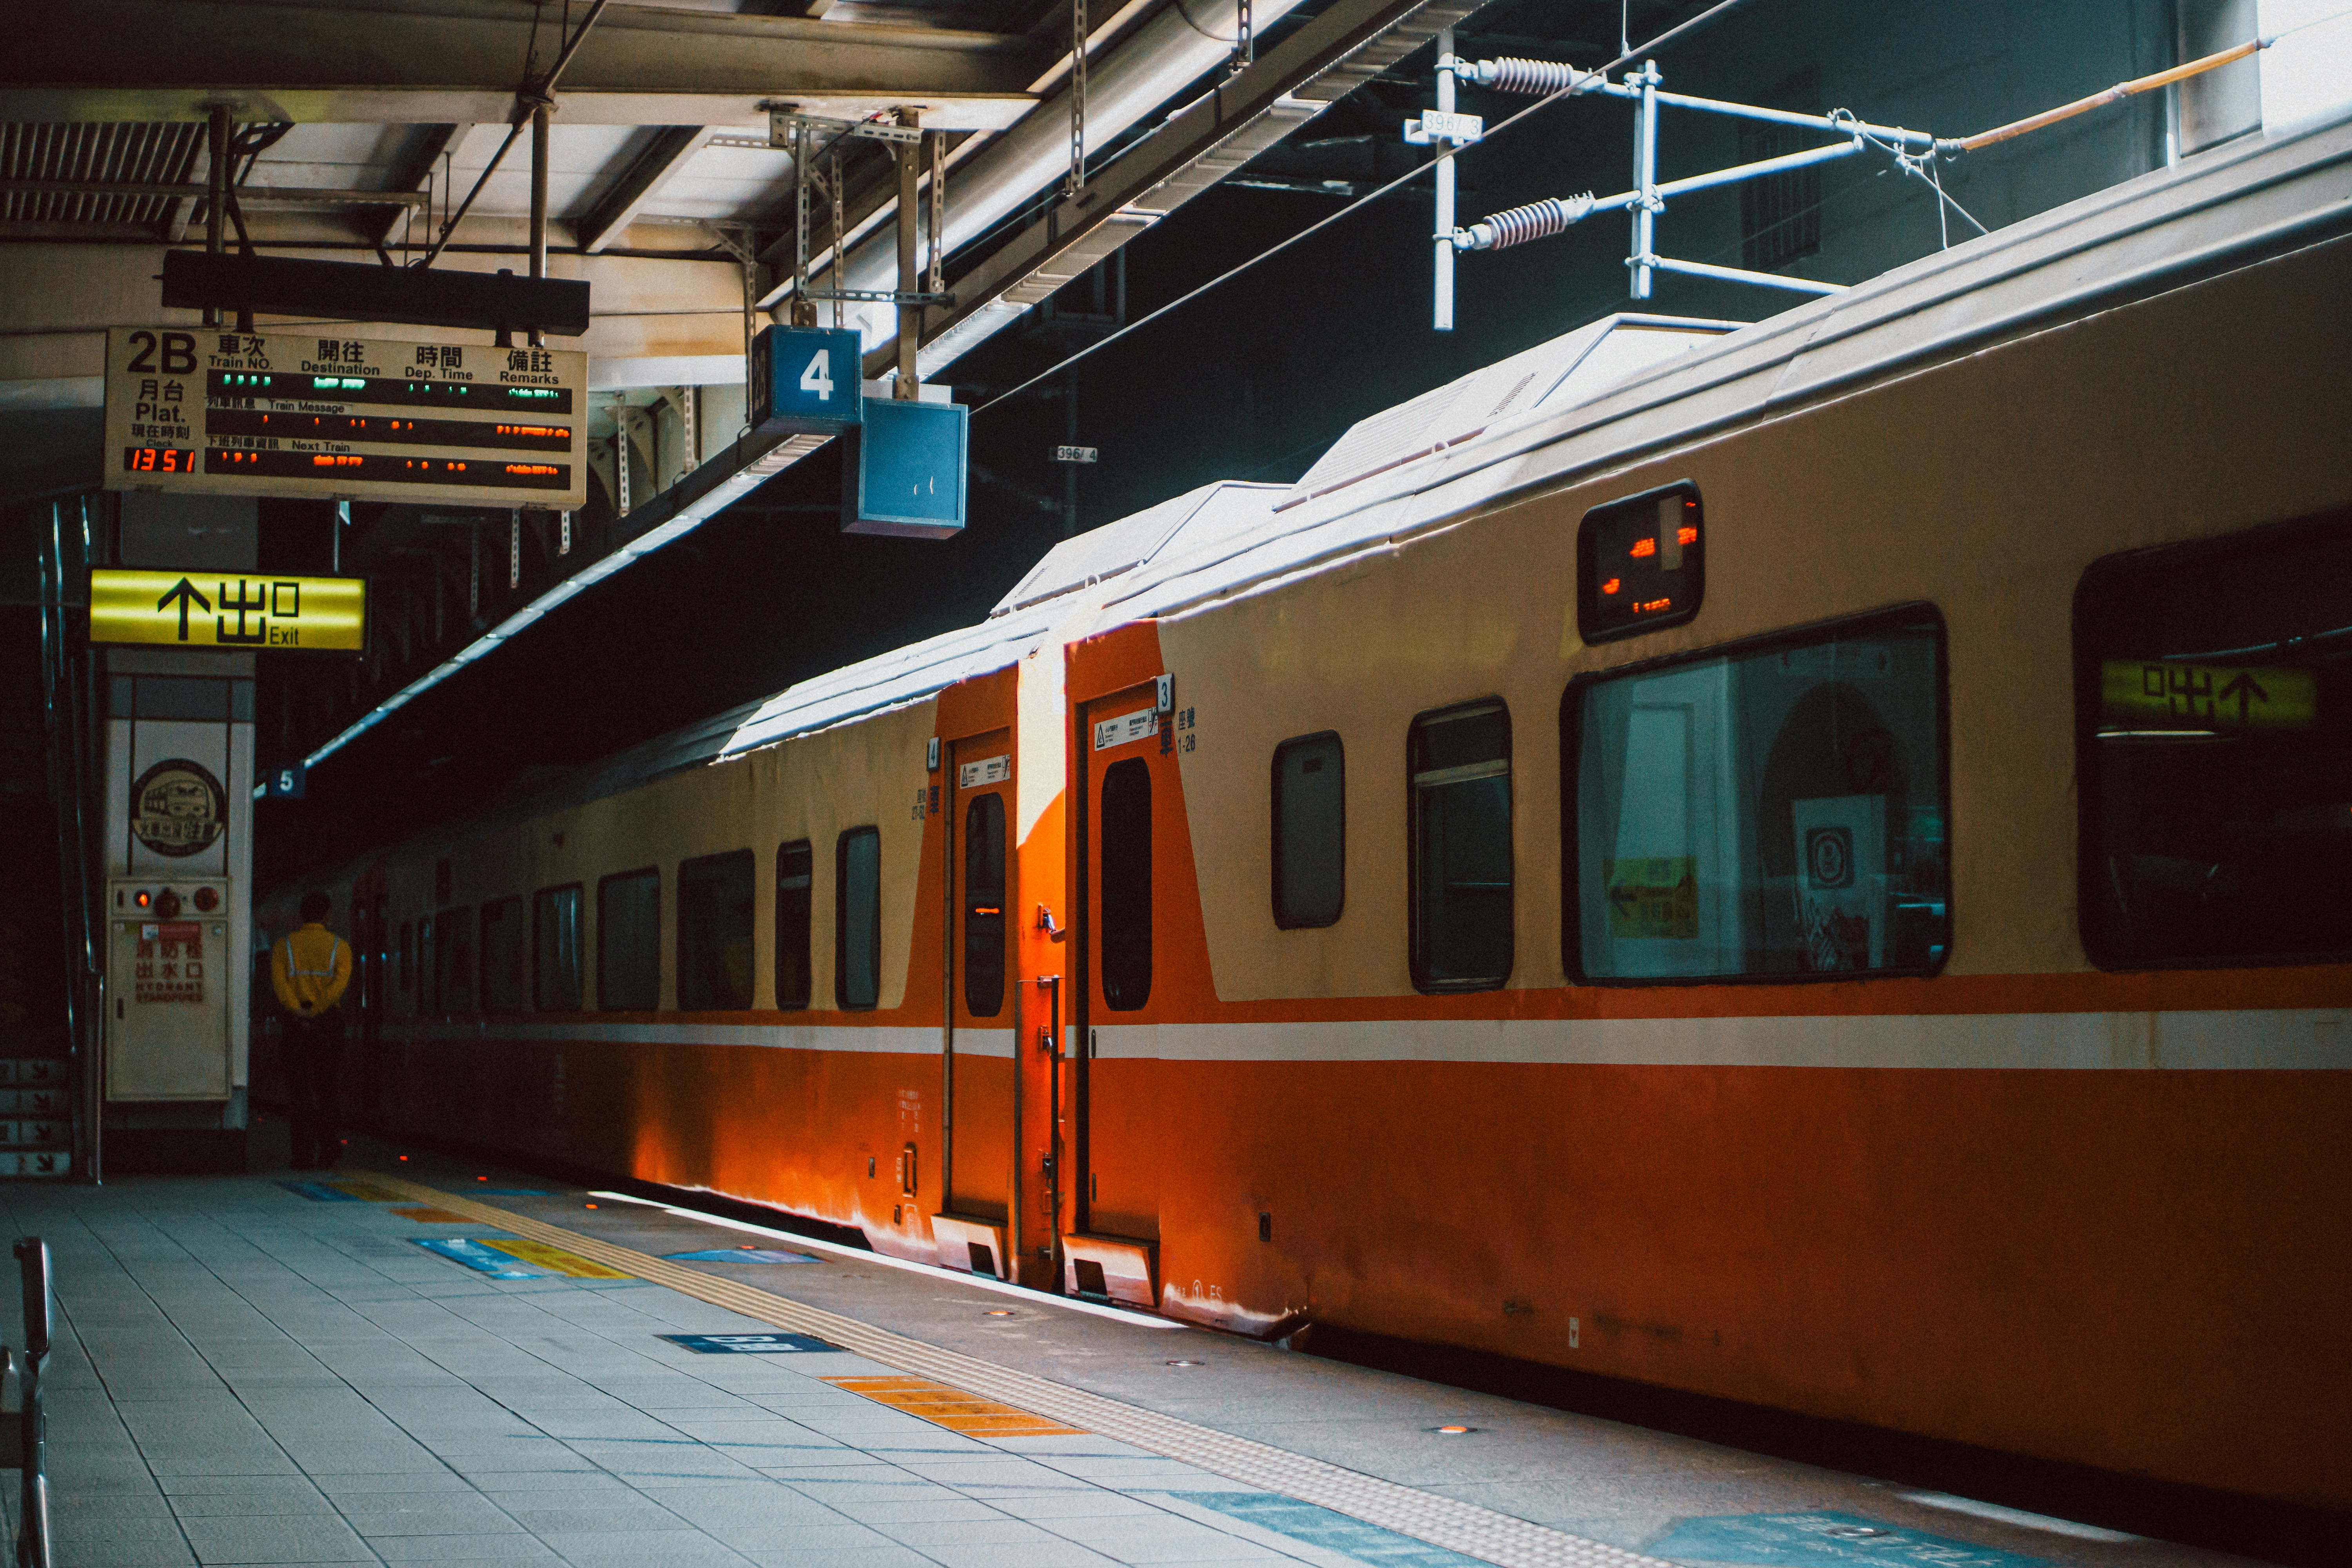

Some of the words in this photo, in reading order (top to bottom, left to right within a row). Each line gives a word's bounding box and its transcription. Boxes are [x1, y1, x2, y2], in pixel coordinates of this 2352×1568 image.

[127, 331, 197, 374] 2B
[218, 335, 265, 357] 車次
[318, 339, 364, 363] 開往
[209, 356, 243, 368] Train
[248, 359, 273, 369] NO.
[416, 346, 462, 368] 時間
[507, 350, 552, 372] 備註
[301, 360, 380, 376] Destination
[405, 367, 435, 381] Dep.
[441, 368, 473, 380] Time
[500, 371, 559, 385] Remarks
[800, 349, 833, 400] 4
[139, 379, 183, 402] 月台
[136, 403, 185, 422] Plat.
[268, 400, 294, 411] Train
[299, 401, 345, 414] Message
[131, 424, 189, 439] 現在時刻
[292, 440, 319, 451] Next
[325, 442, 350, 452] Train
[216, 579, 299, 644] 出口
[269, 627, 299, 646] Exit
[1161, 682, 1168, 707] 3
[280, 769, 293, 791] 5
[136, 961, 203, 978] 出水口
